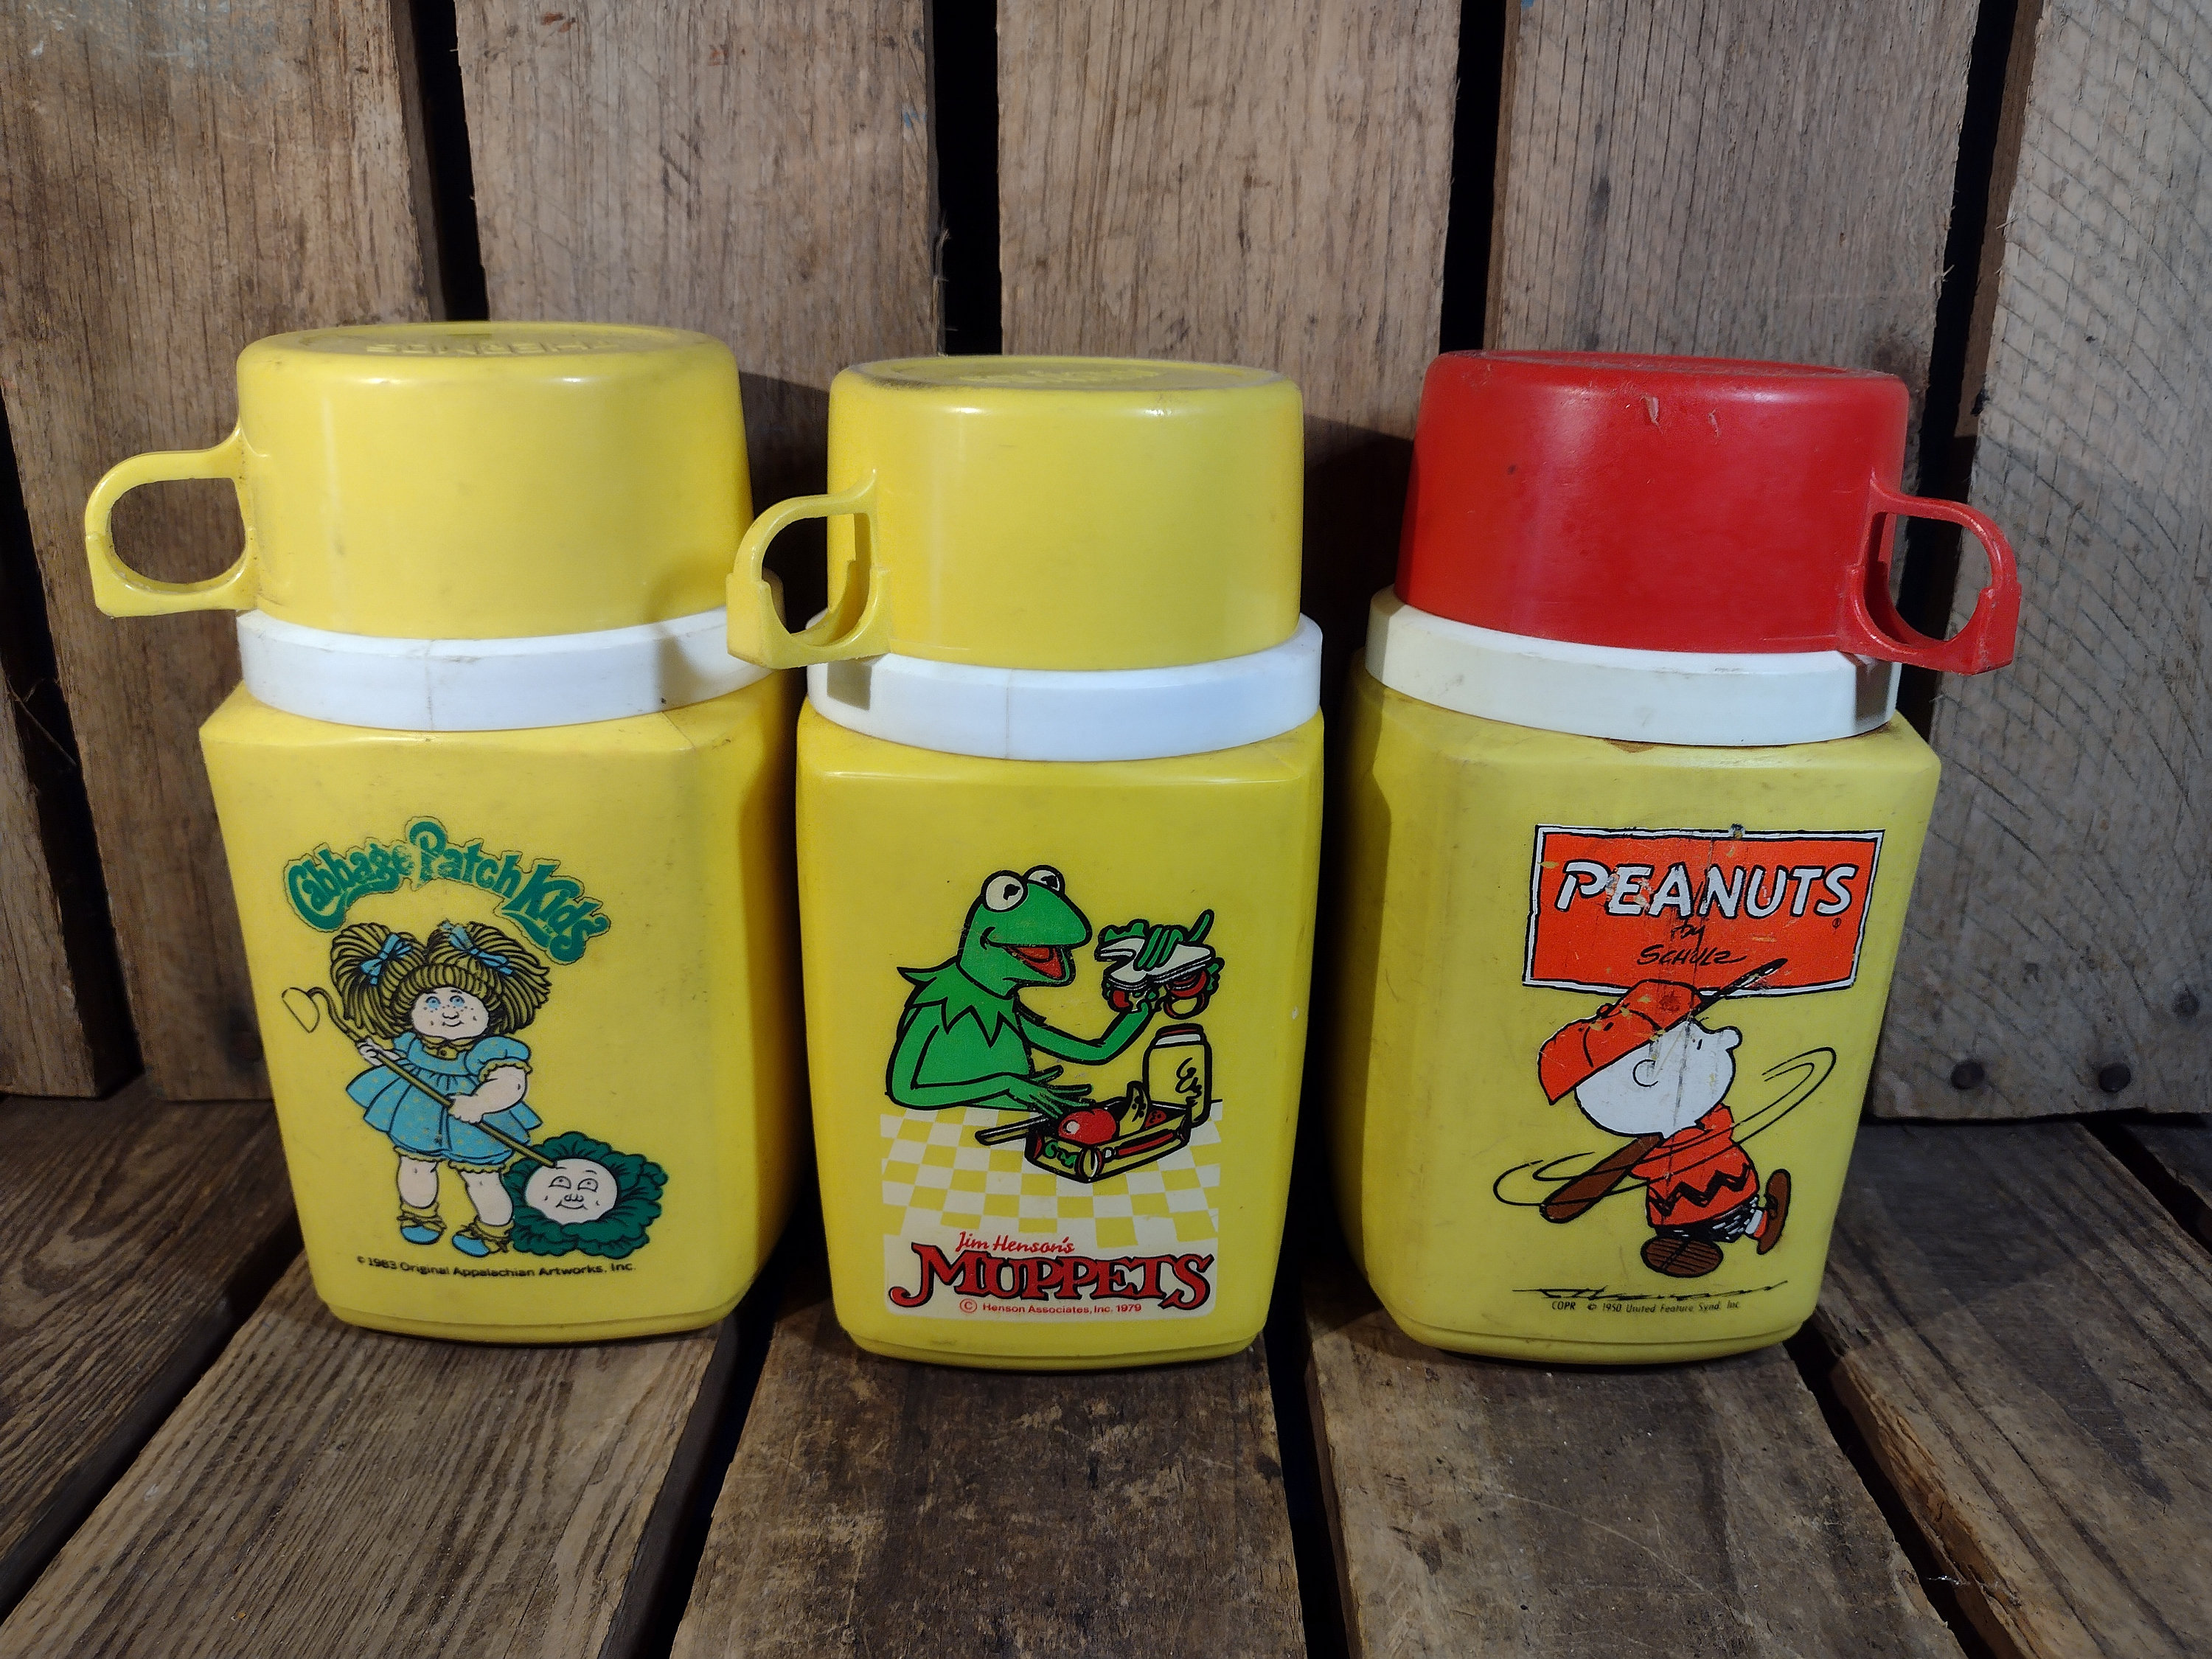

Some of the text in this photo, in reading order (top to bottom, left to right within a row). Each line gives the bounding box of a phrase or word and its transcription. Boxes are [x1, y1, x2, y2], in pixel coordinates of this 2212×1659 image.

[288, 821, 610, 962] Cabbage Patch Kids
[1555, 859, 1859, 919] PEANUTS
[1671, 922, 1705, 948] by
[956, 1231, 1075, 1254] Jim Henson's
[368, 1257, 397, 1270] 1983
[400, 1262, 450, 1276] Original
[453, 1266, 535, 1278] Appalachian
[888, 1242, 1215, 1310] MUPPETS
[982, 1302, 1026, 1313] Henson
[1028, 1304, 1092, 1315] Associates,
[1093, 1304, 1113, 1313] Inc.
[1116, 1303, 1142, 1312] 1979
[1551, 1301, 1576, 1310] COPR
[1602, 1303, 1622, 1312] 1950
[1626, 1304, 1656, 1313] United
[1660, 1303, 1694, 1312] Feature
